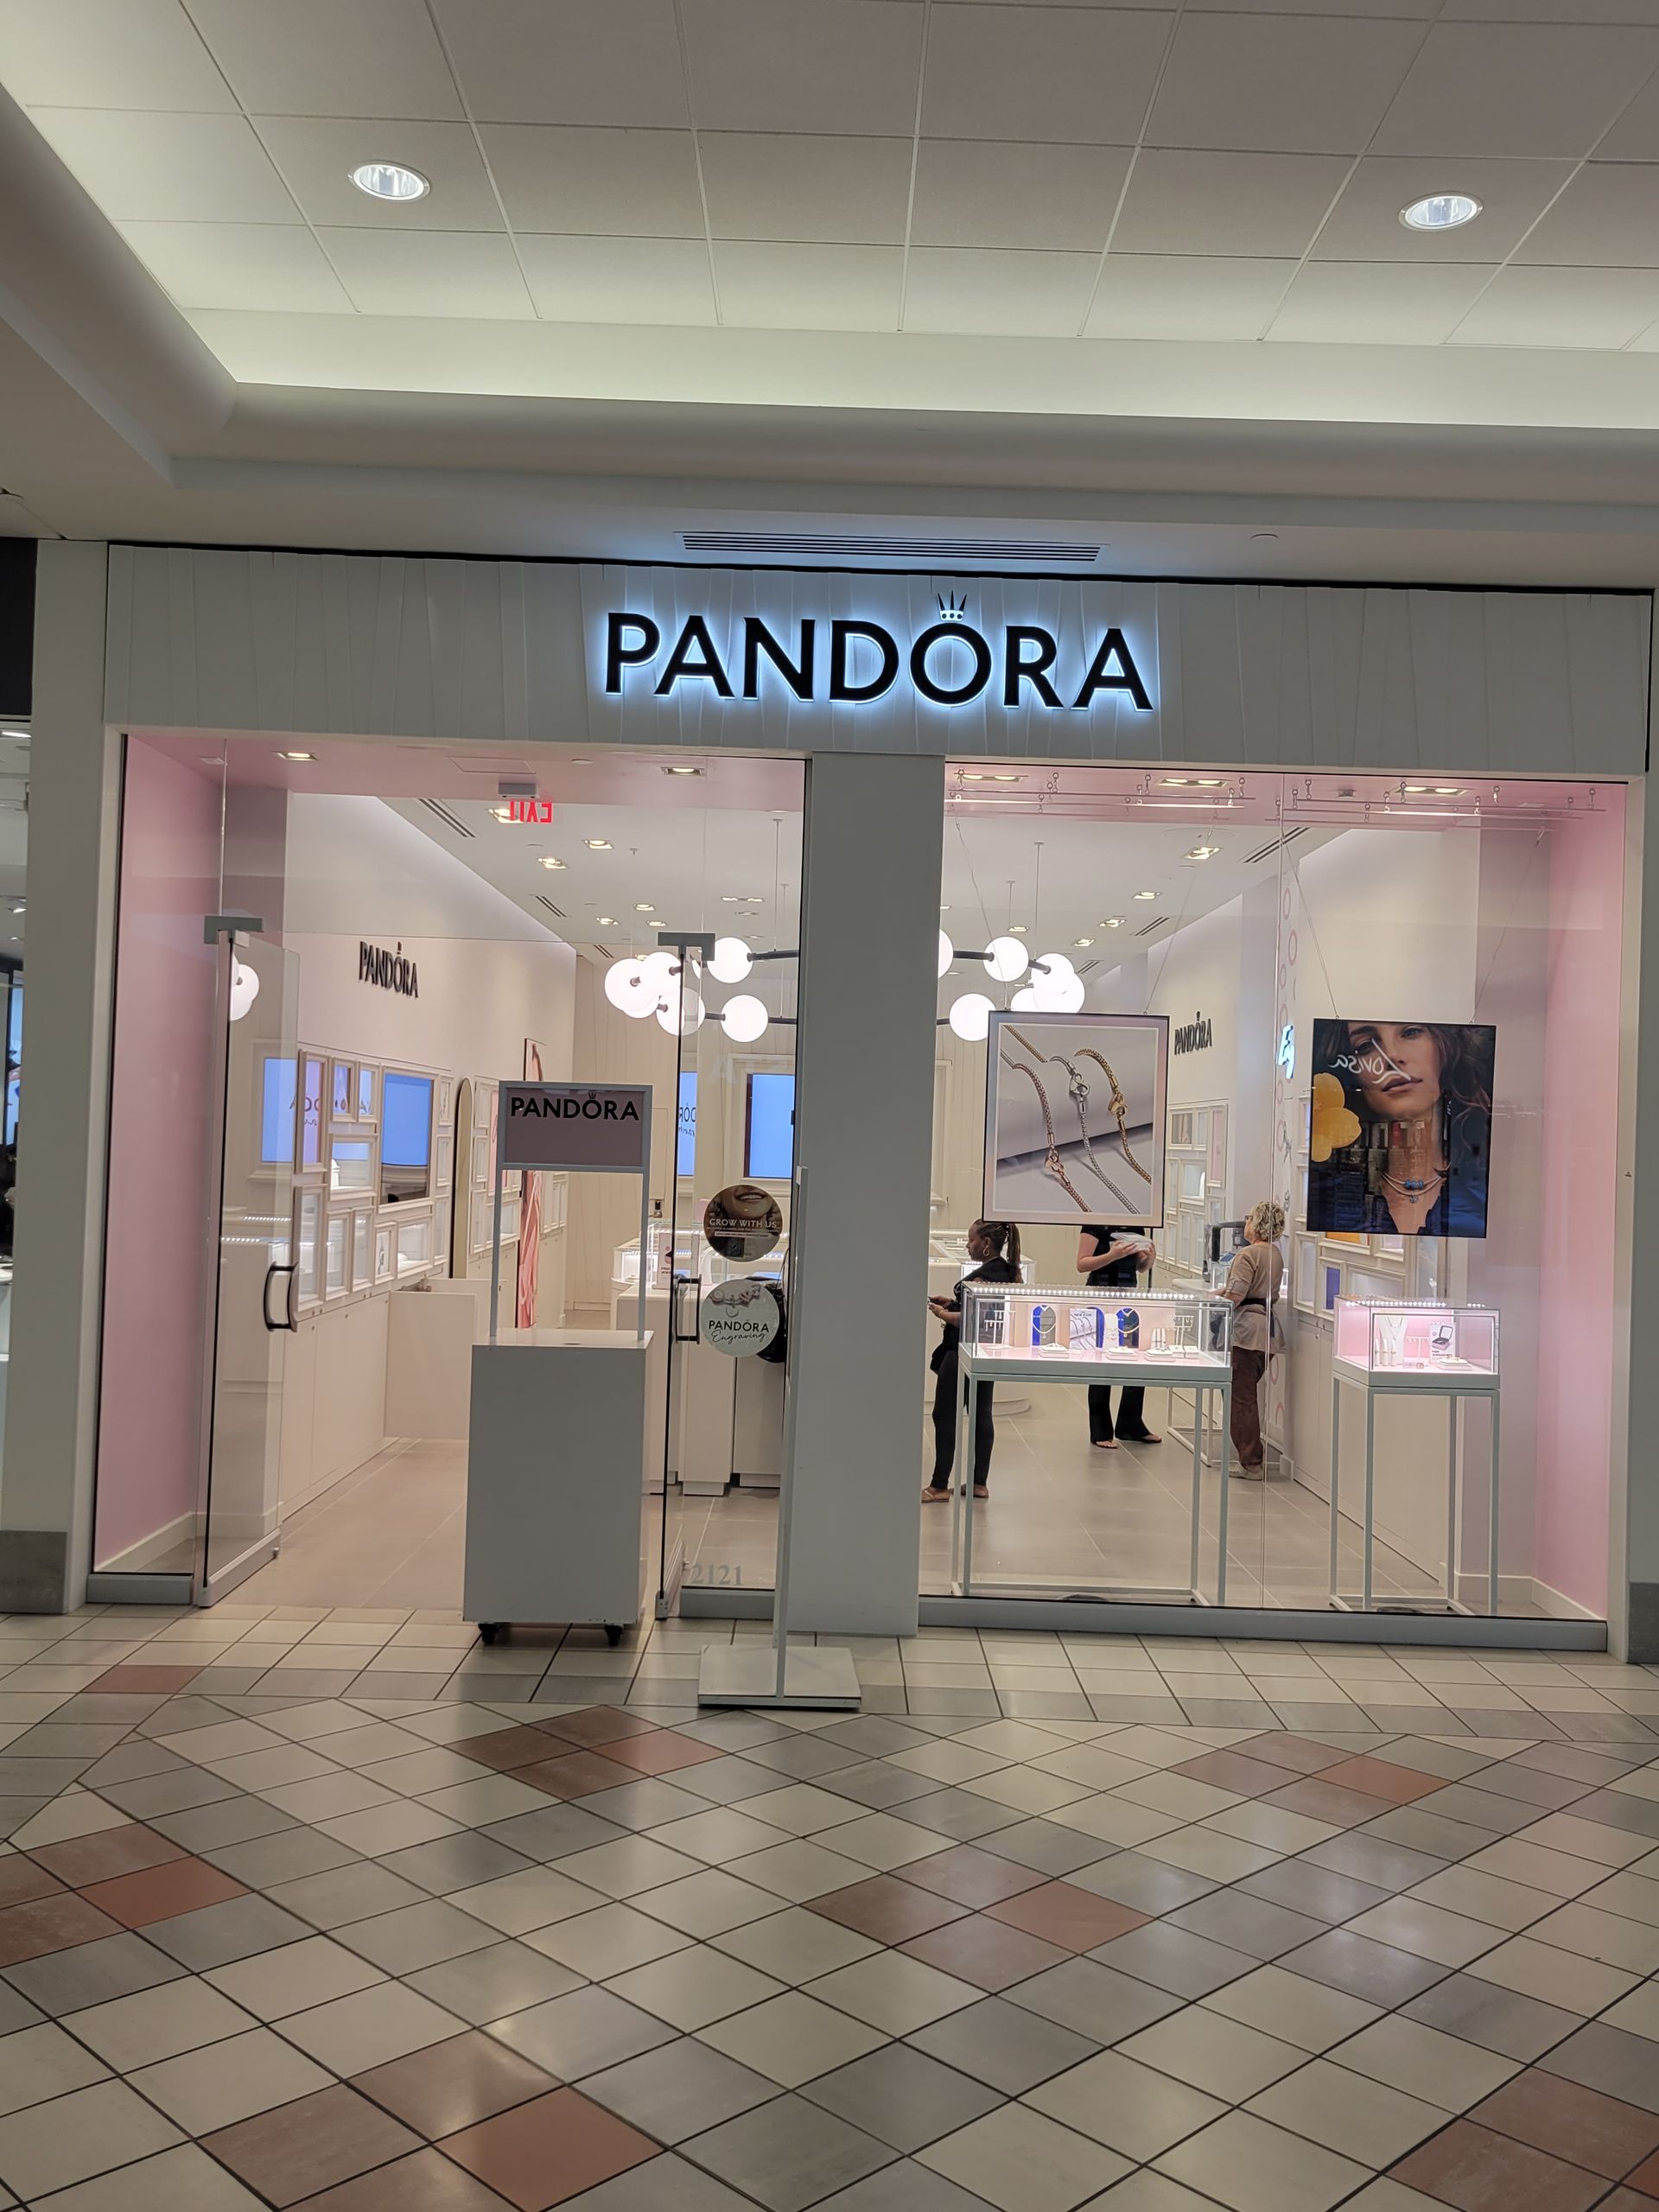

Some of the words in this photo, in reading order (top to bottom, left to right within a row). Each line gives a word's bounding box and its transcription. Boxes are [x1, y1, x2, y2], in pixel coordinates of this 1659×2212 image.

[605, 610, 1153, 711] PANDORA
[359, 941, 419, 998] PANDORA
[1174, 1016, 1212, 1055] PANDORA
[511, 1096, 639, 1121] PANDORA
[709, 1217, 737, 1226] GROW
[739, 1219, 762, 1228] WITH
[709, 1320, 769, 1332] PANDORA
[711, 1330, 766, 1344] Engraving
[691, 1562, 743, 1586] 2121
